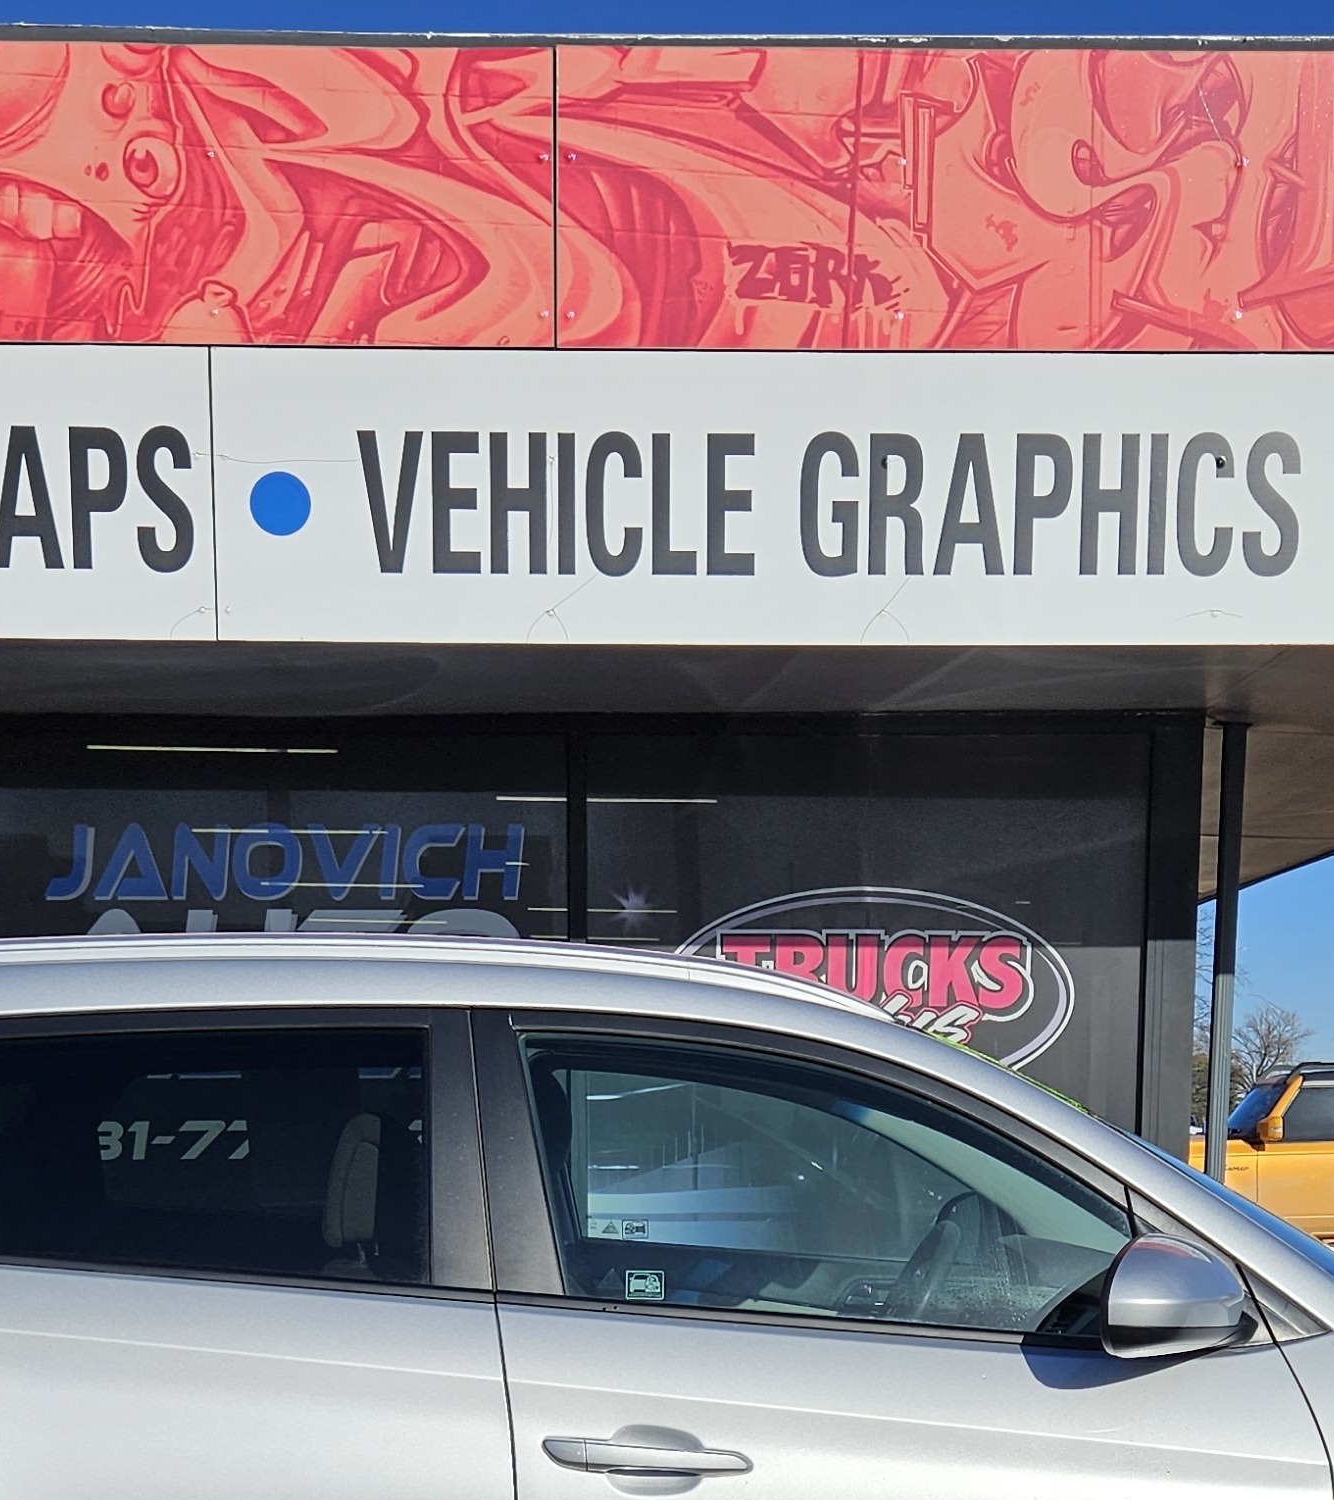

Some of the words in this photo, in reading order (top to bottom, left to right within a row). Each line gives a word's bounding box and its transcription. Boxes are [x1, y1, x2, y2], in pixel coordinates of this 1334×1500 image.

[356, 430, 755, 577] VEHICLE
[799, 431, 1301, 577] GRAPHICS
[45, 822, 524, 900] JANOVICH
[720, 932, 1029, 1012] TRUCKS
